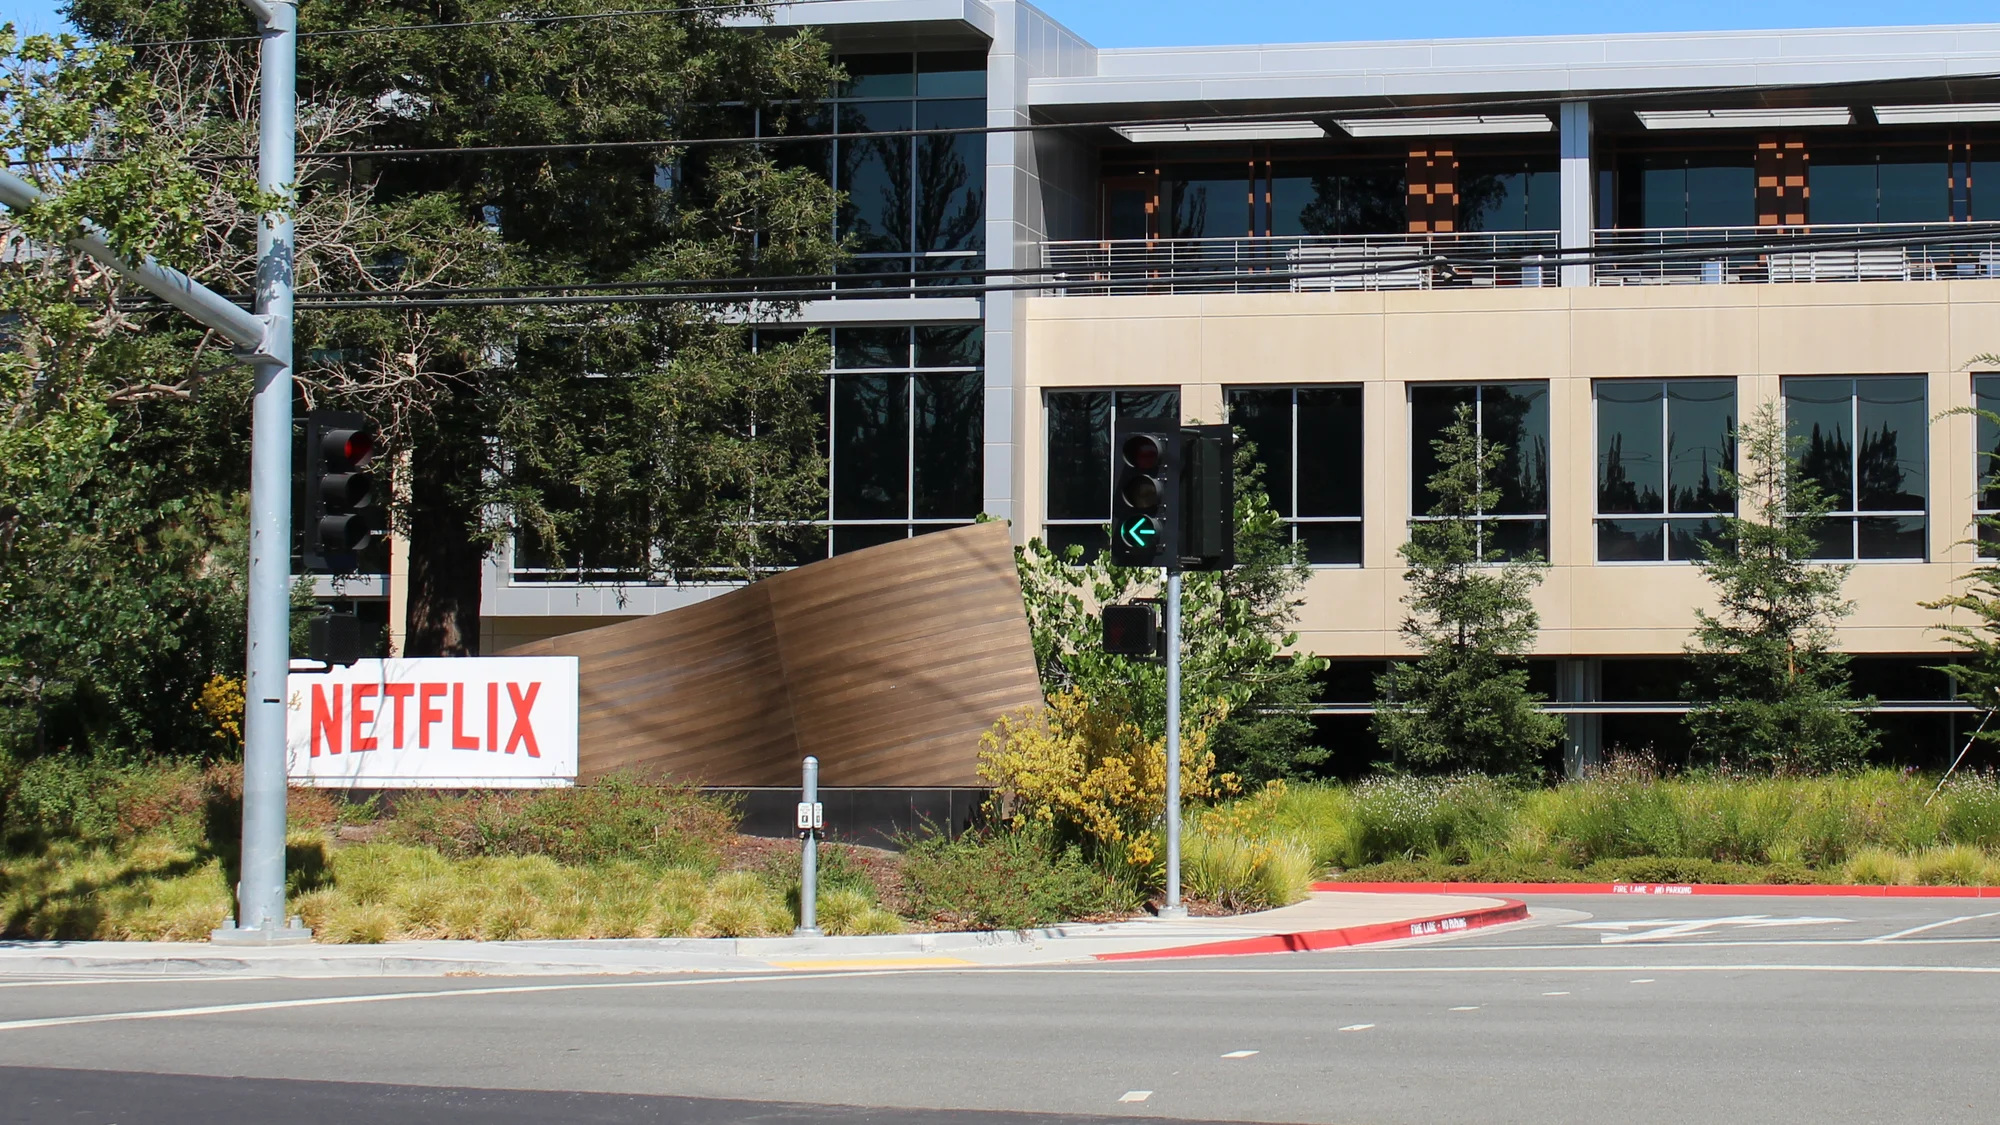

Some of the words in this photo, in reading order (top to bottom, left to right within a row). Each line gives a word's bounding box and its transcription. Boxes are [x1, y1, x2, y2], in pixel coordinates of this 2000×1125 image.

[310, 681, 542, 758] NETFLIX
[1613, 885, 1628, 893] FIRE
[1630, 885, 1647, 893] LANE
[1654, 885, 1665, 894] NO
[1665, 886, 1692, 894] PARKING
[1410, 923, 1423, 935] FIRE
[1423, 921, 1437, 933] LANE
[1441, 919, 1449, 930] NO
[1449, 917, 1467, 929] PARKING
